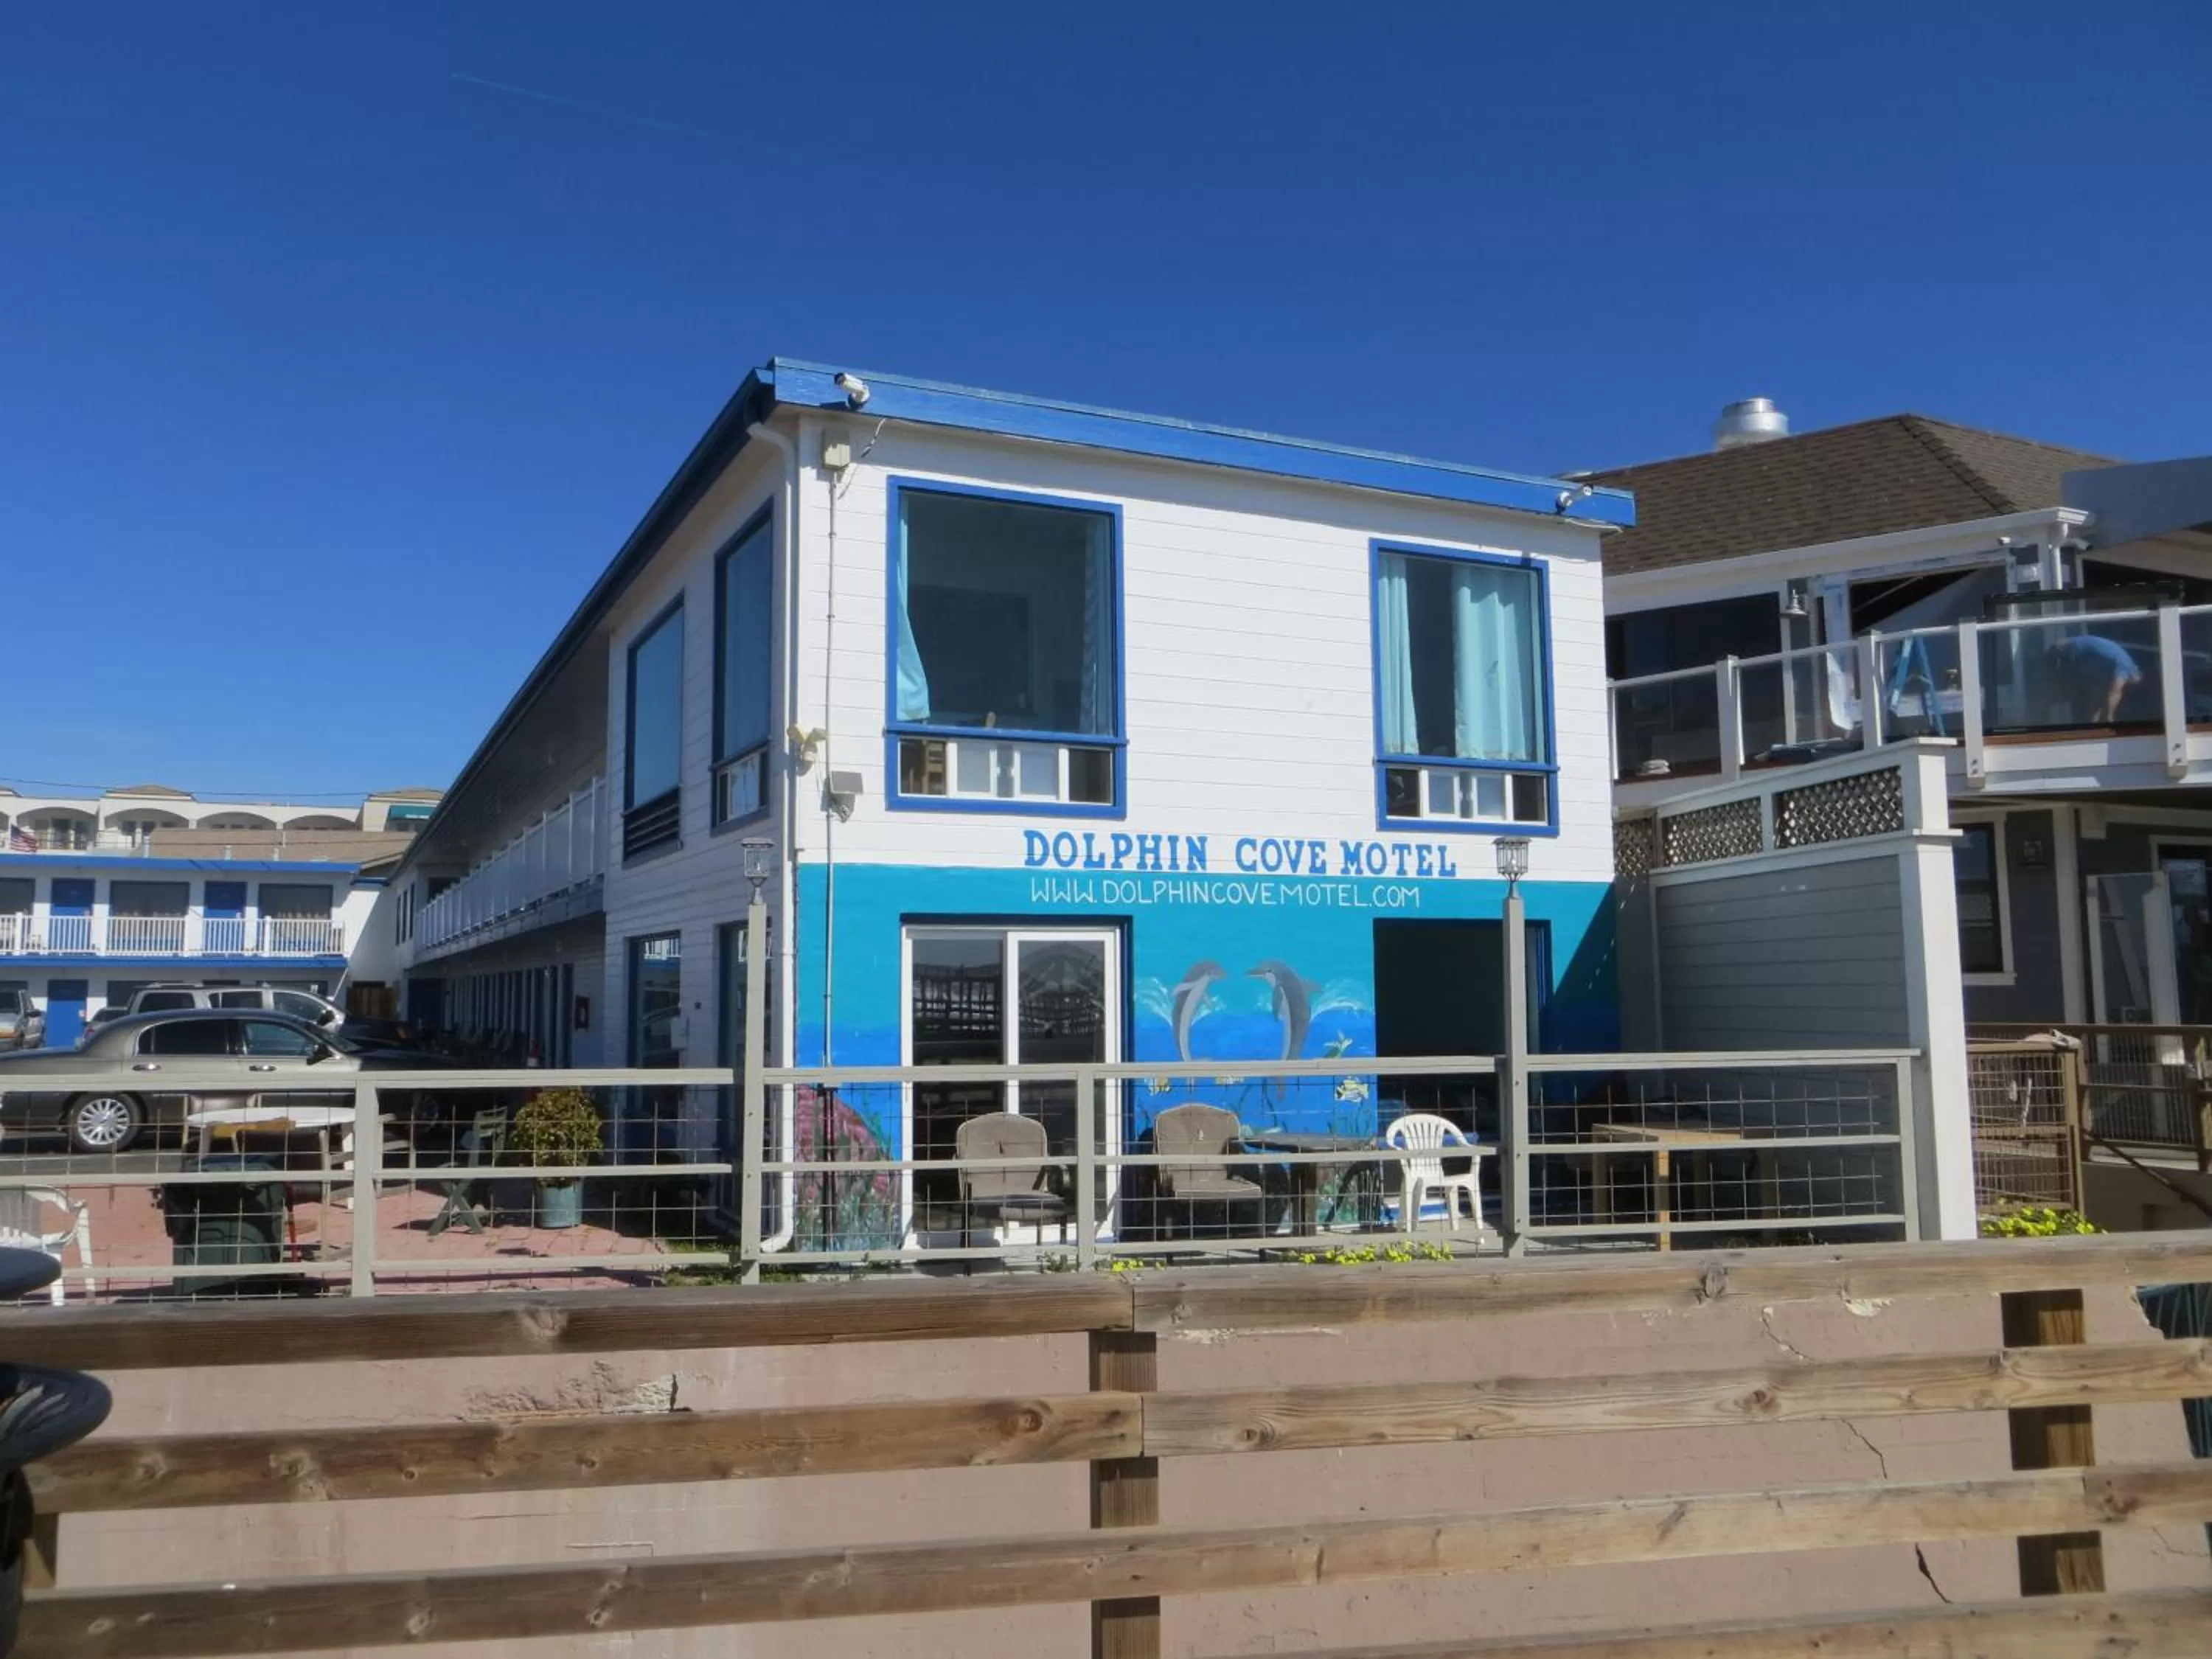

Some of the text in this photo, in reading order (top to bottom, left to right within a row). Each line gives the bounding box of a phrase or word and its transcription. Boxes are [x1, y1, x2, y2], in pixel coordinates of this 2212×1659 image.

[1023, 830, 1456, 877] DOLPHIN COVE MOTEL
[1031, 877, 1420, 908] WWW.DOLPHINCOVEMOTEL.COM
